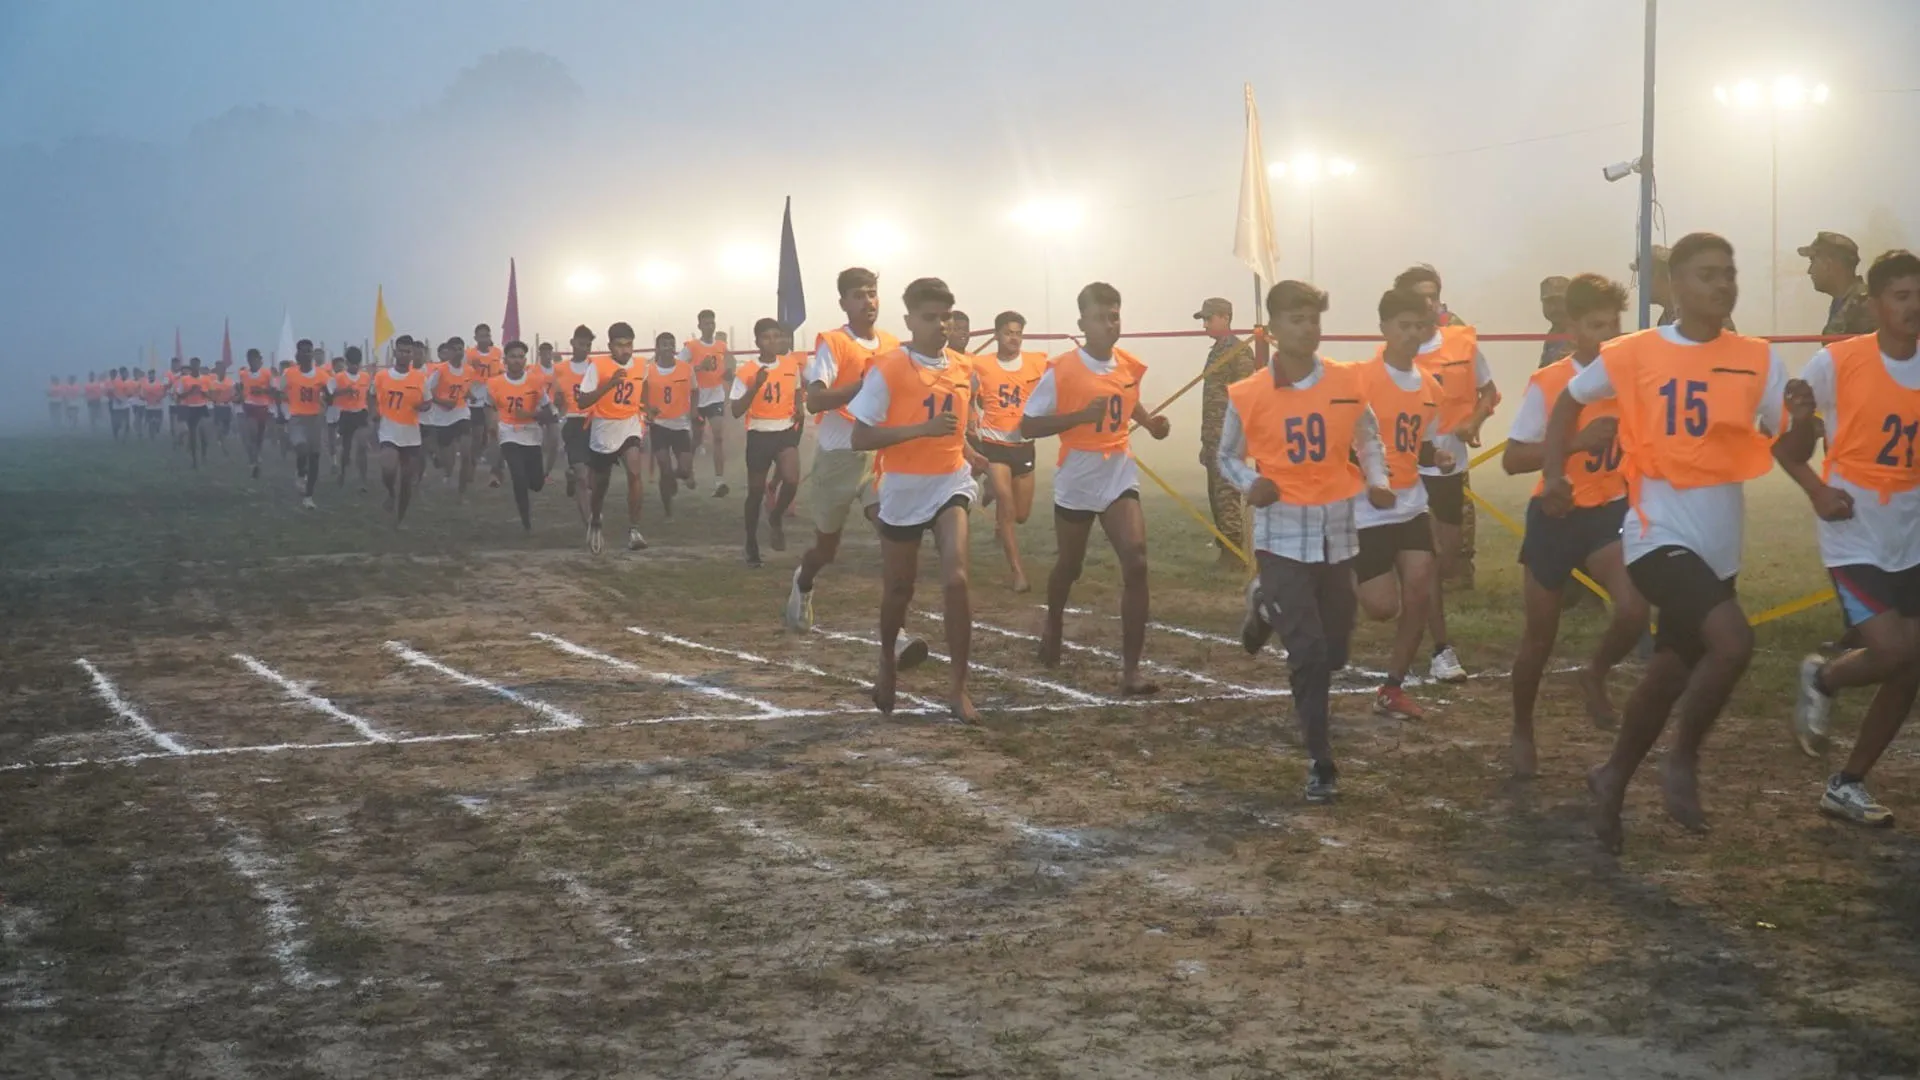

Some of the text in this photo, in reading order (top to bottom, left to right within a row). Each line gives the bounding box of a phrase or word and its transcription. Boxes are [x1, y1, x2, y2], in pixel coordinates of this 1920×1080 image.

[388, 391, 404, 409] 77
[616, 382, 633, 404] 82
[664, 387, 671, 404] 8
[764, 382, 781, 404] 41
[999, 384, 1021, 408] 54
[1660, 378, 1708, 437] 15
[1286, 413, 1326, 464] 59
[1396, 412, 1421, 453] 63
[1876, 414, 1920, 468] 21
